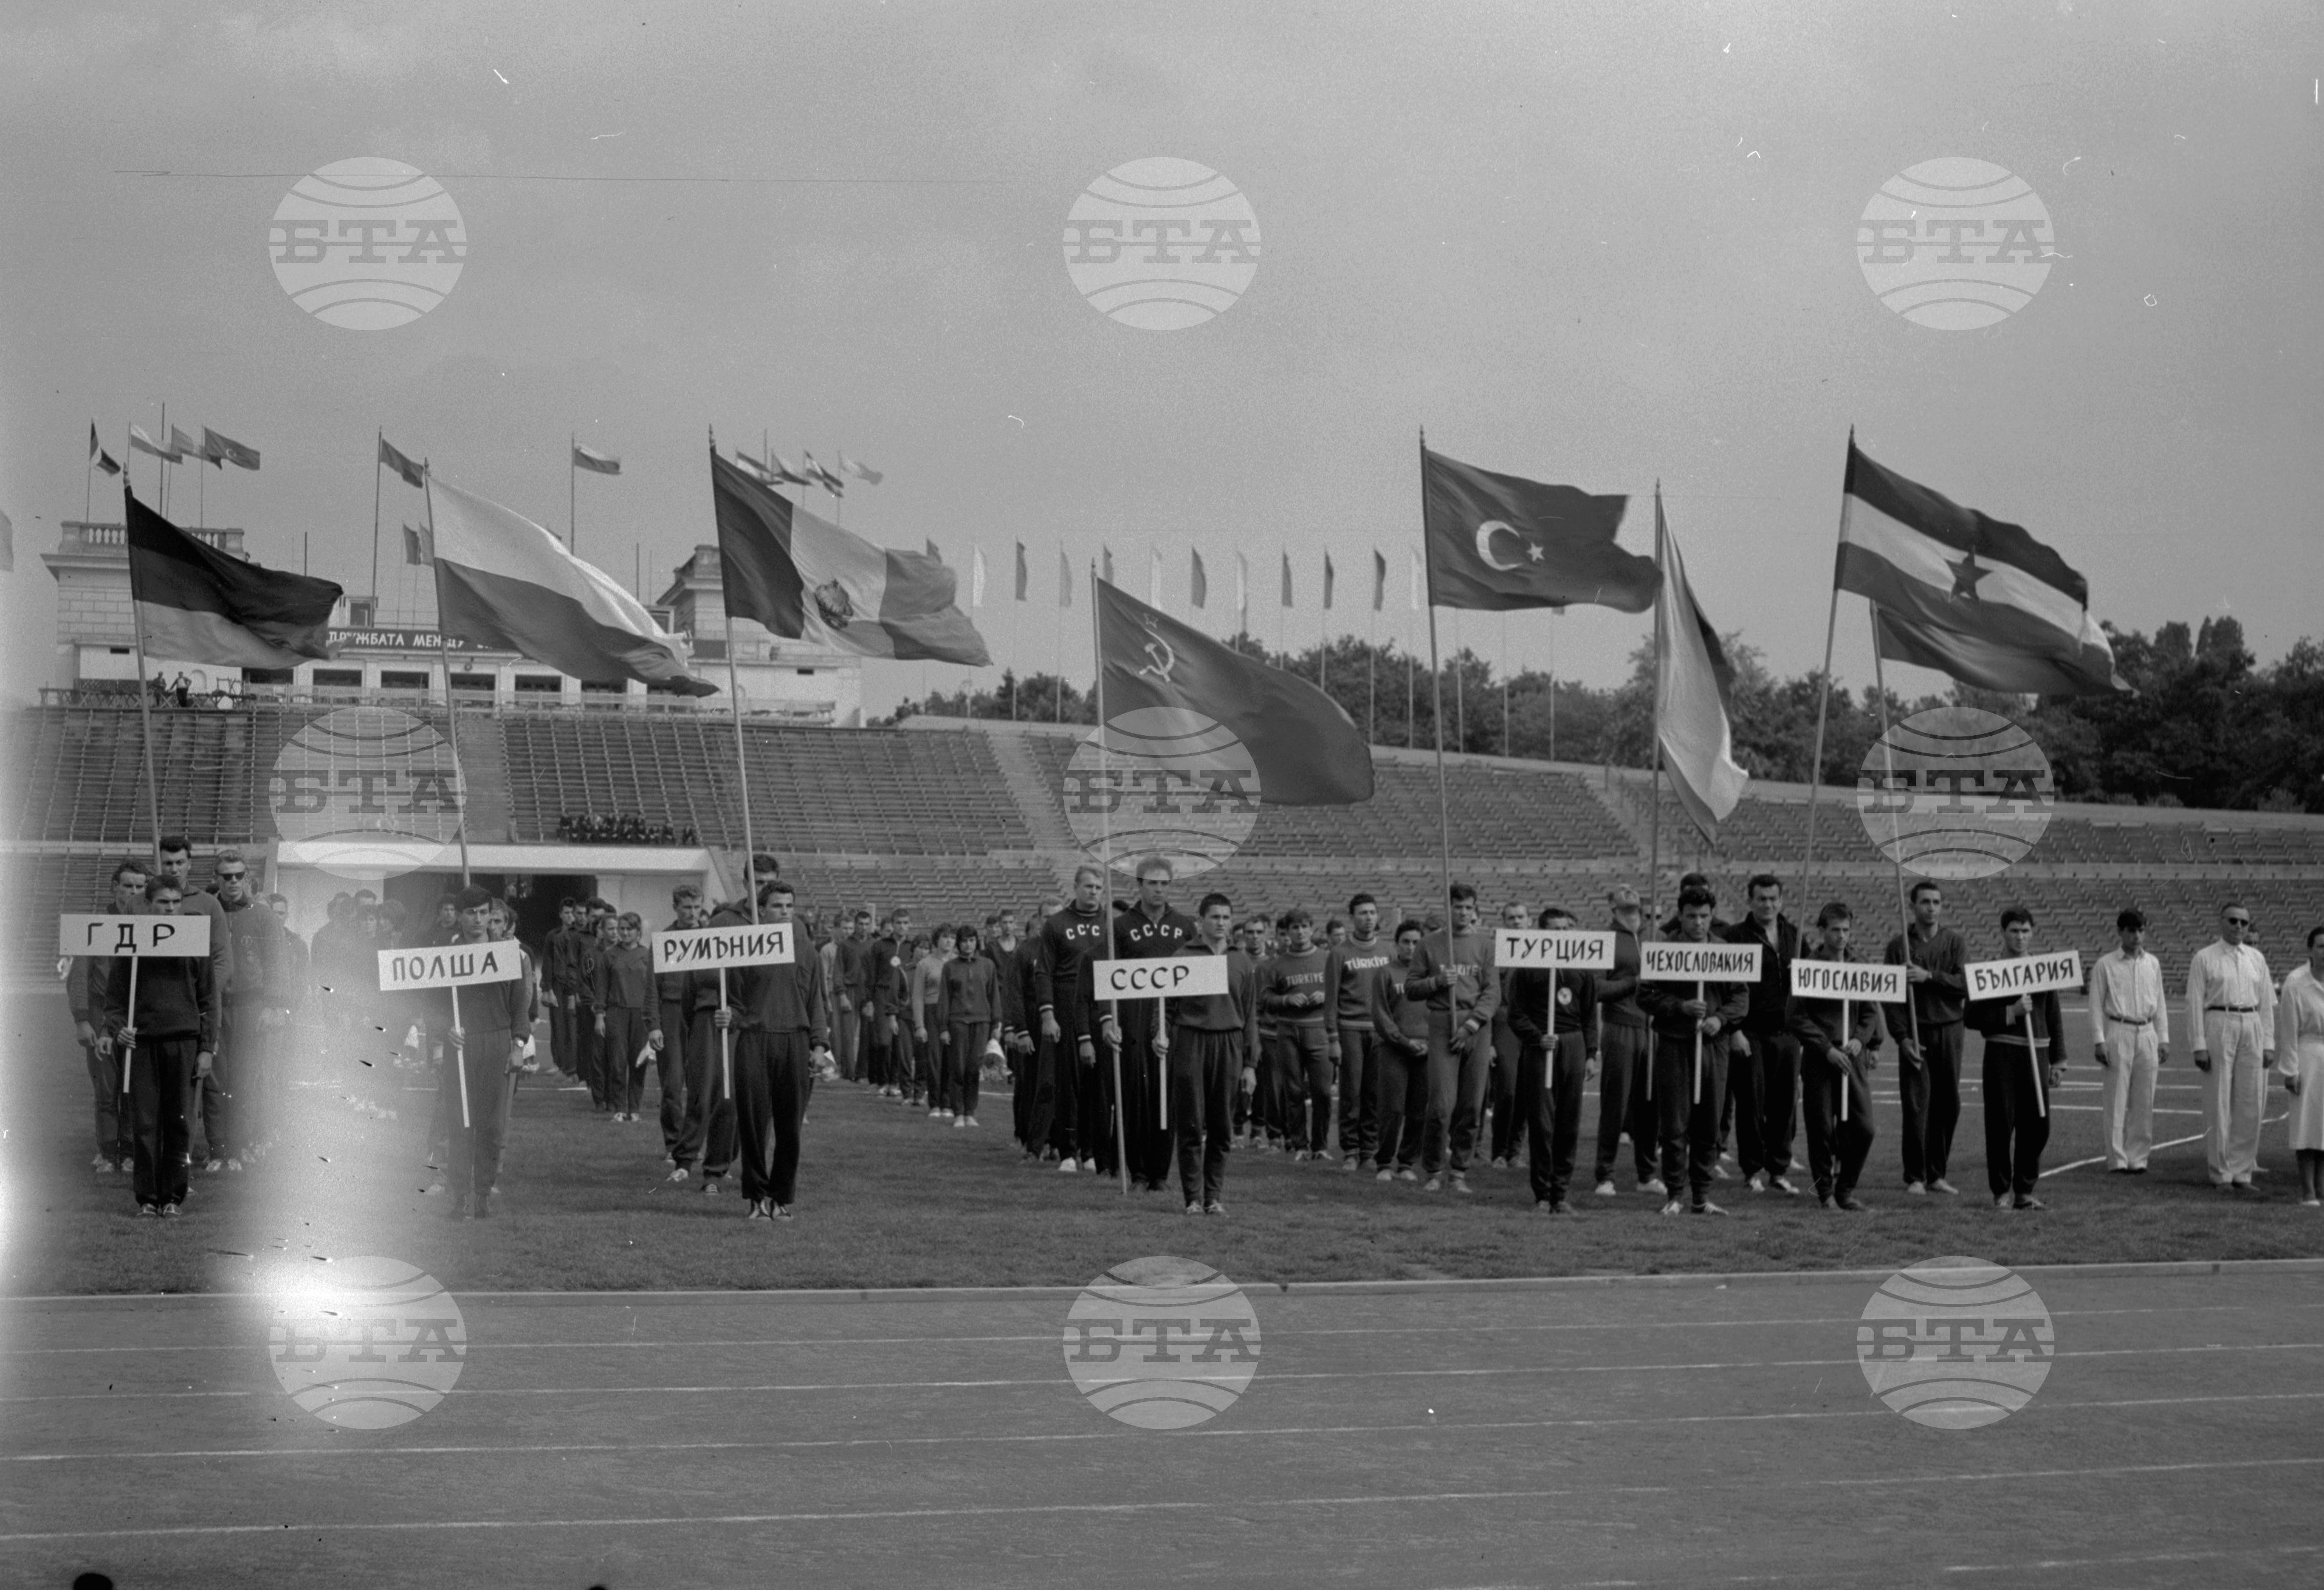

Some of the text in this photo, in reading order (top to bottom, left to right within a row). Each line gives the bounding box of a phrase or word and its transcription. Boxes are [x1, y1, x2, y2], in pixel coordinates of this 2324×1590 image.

[88, 923, 175, 954] ГДР
[1067, 923, 1100, 940] ССС
[1130, 923, 1183, 941] СССР
[664, 931, 784, 964] РУМЪНИЯ
[1506, 937, 1604, 962] ТУРЦИЯ
[392, 950, 498, 982] ПОЛША
[1646, 950, 1754, 974] ЧЕХОСЛОВАКИЯ
[1974, 957, 2075, 992] БЪЛГАРИЯ
[1110, 965, 1189, 991] СССР
[1798, 967, 1898, 994] ЮГОСЛАВИЯ
